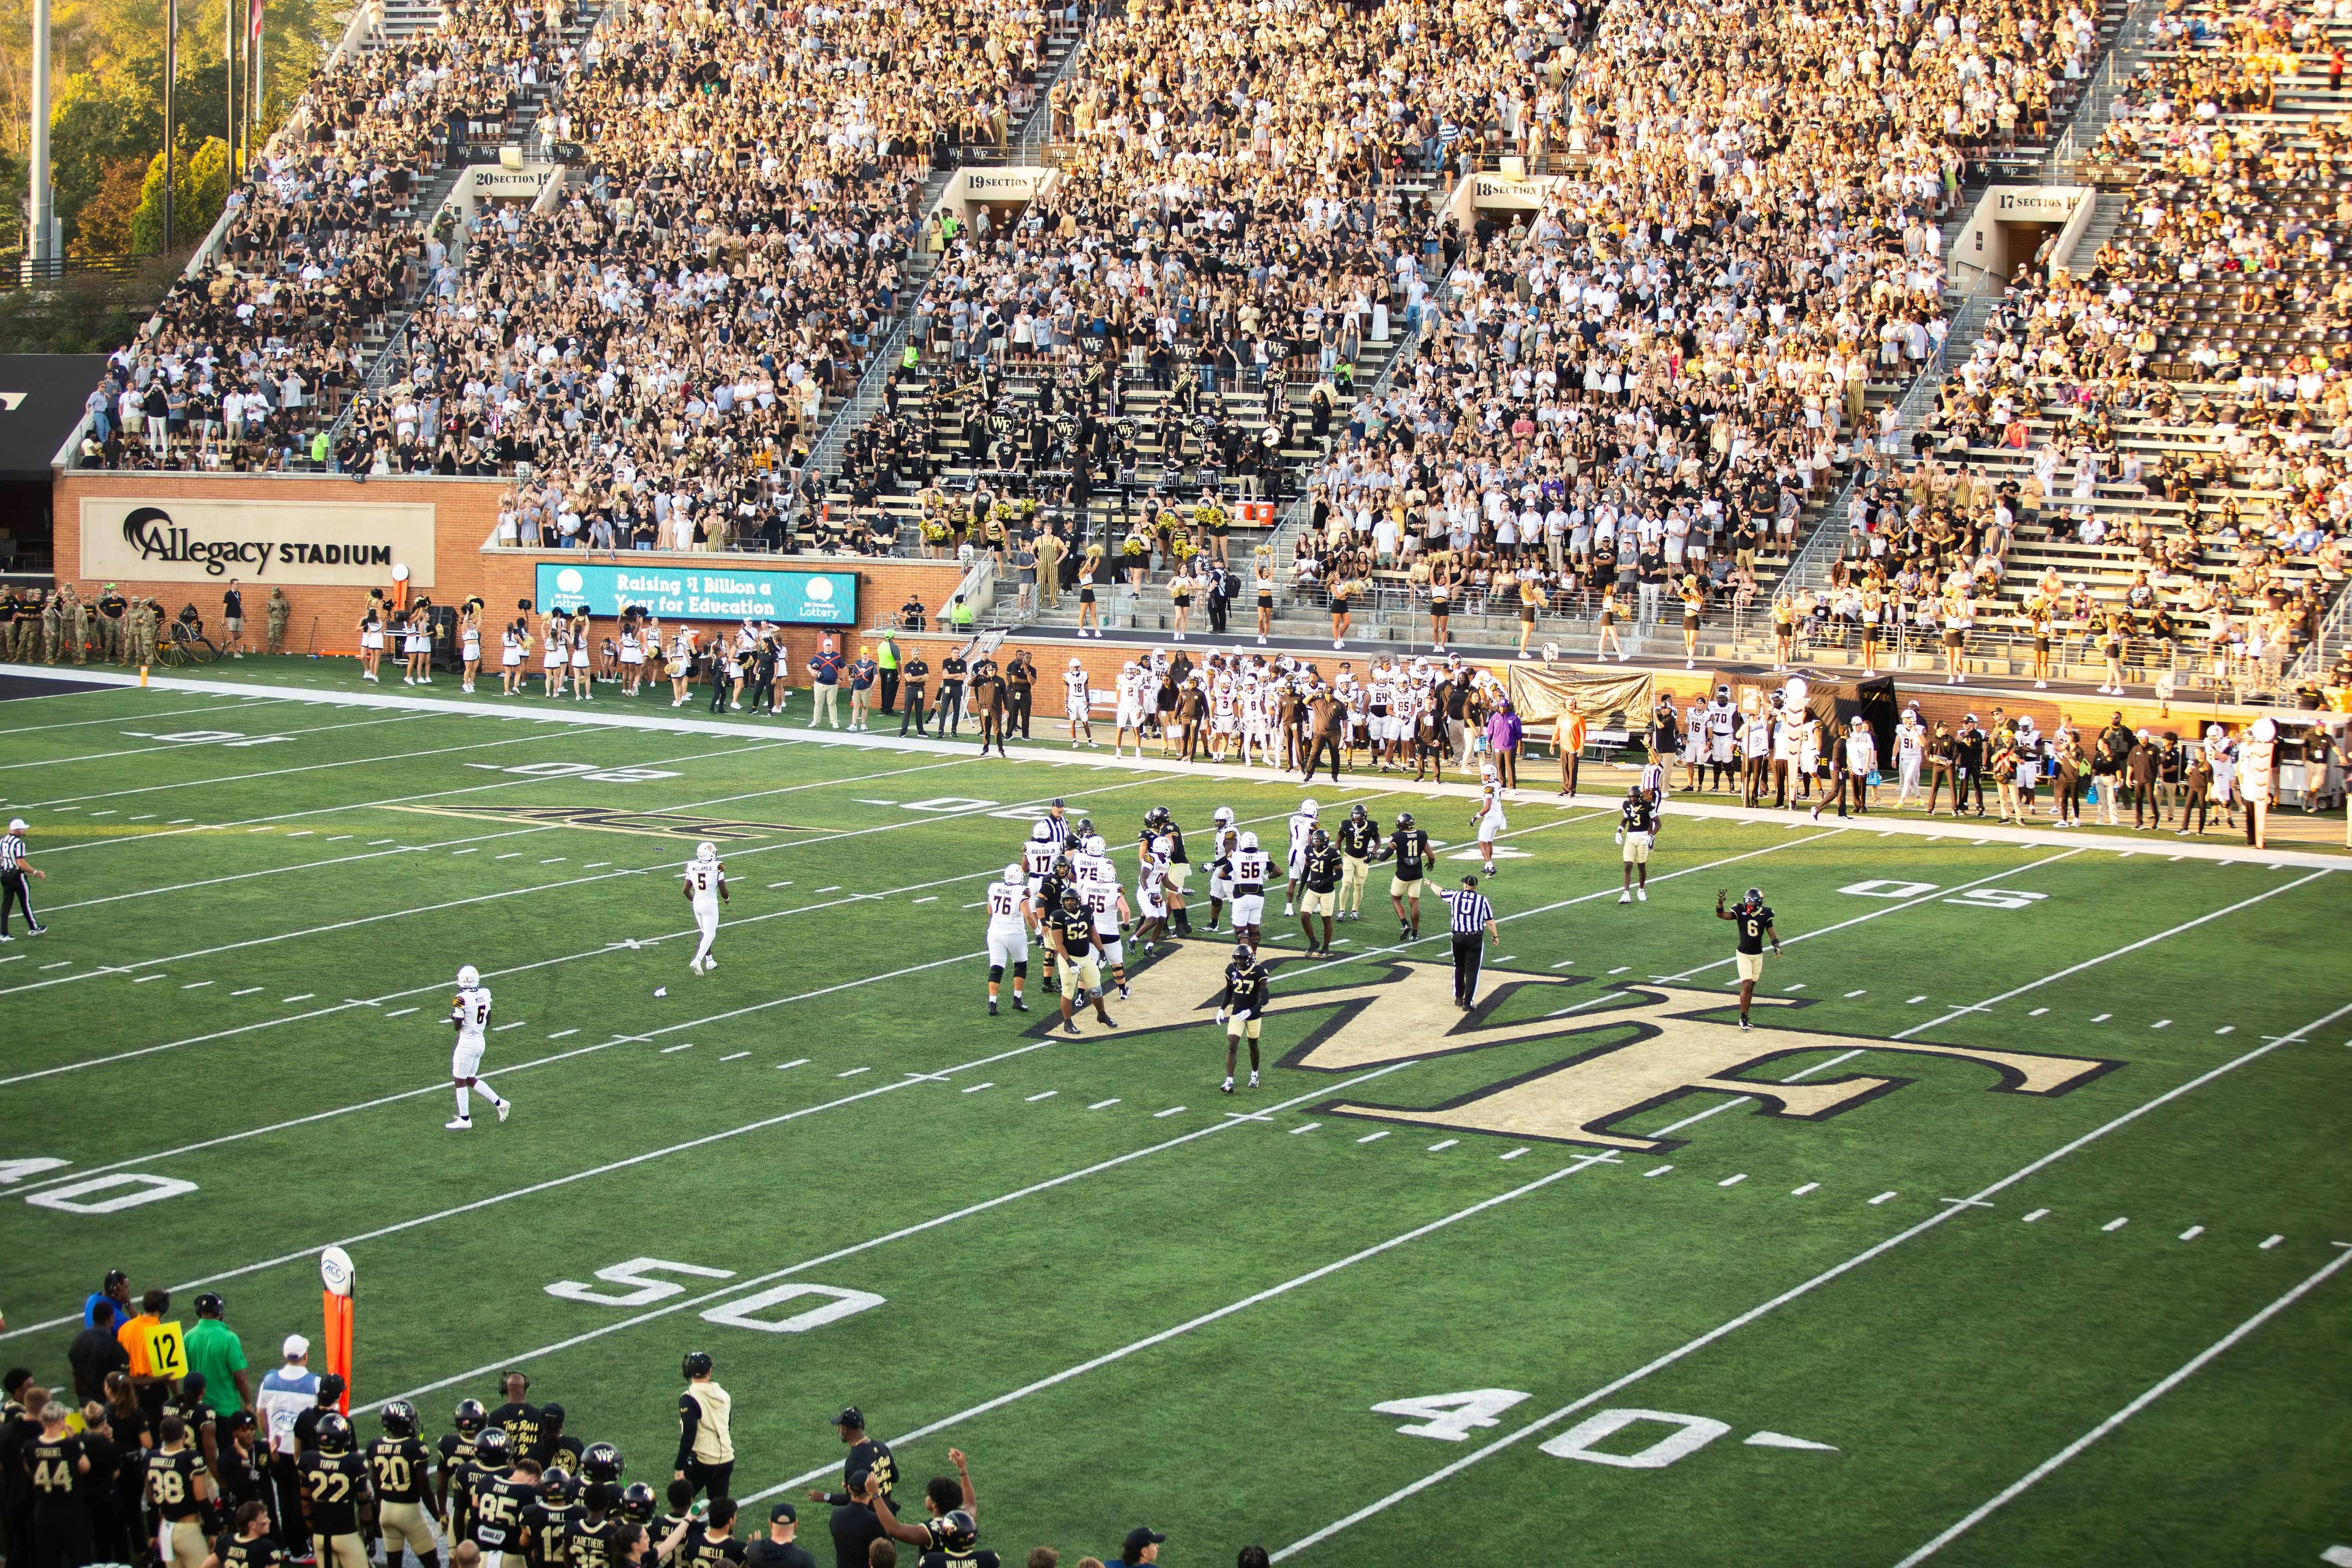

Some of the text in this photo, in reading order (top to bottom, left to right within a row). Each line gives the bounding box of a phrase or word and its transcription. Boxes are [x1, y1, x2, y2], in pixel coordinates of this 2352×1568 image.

[481, 146, 496, 158] WF
[972, 148, 988, 159] WF
[1052, 148, 1068, 160] WF
[1561, 156, 1577, 168] WF
[2002, 165, 2018, 176] WF
[2086, 167, 2103, 180] WF
[2112, 168, 2131, 181] WF
[476, 173, 493, 186] 20
[494, 175, 535, 184] SECTION
[969, 176, 984, 189] 19
[985, 178, 1028, 187] SECTION
[1476, 183, 1492, 196] 18
[1493, 185, 1537, 195] SECTION
[1999, 195, 2013, 209] 17
[2016, 198, 2062, 208] SECTION
[1081, 337, 1103, 352] WF
[1174, 342, 1196, 360] WF
[1267, 341, 1289, 358] WF
[991, 417, 1011, 433] WF
[1057, 422, 1074, 436] WF
[1118, 424, 1134, 437] WF
[1193, 423, 1207, 436] WF
[141, 526, 391, 576] Allegacy STADIUM
[617, 573, 771, 596] Raising $1 Billion a
[551, 598, 590, 608] Lottery
[614, 593, 775, 616] Year for Education
[799, 606, 840, 620] Lottery
[1074, 683, 1082, 693] 18
[1128, 687, 1134, 697] 2
[1376, 692, 1387, 703] 64
[1398, 701, 1409, 712] 85
[1715, 712, 1727, 724] 70
[1692, 721, 1701, 733] 16
[1904, 737, 1913, 749] 91
[369, 805, 851, 842] ACC
[1632, 814, 1641, 826] 3
[1294, 824, 1298, 840] 1
[1353, 835, 1363, 850] 5
[1407, 839, 1418, 857] 11
[1036, 855, 1051, 873] 17
[1240, 861, 1261, 879] 56
[1310, 860, 1324, 873] 21
[1080, 867, 1098, 881] 75
[697, 873, 707, 891] 5
[993, 895, 1011, 915] 76
[1087, 894, 1106, 914] 65
[1461, 899, 1474, 914] U
[1066, 921, 1088, 941] 52
[1747, 919, 1758, 938] 6
[1232, 978, 1254, 995] 27
[477, 1005, 486, 1024] 6
[1022, 937, 2129, 1155] WF
[325, 1263, 342, 1276] ACC
[543, 1257, 889, 1332] 50
[153, 1333, 179, 1370] 12
[388, 1402, 408, 1419] WF
[503, 1419, 539, 1433] THE BALL
[1370, 1387, 1733, 1469] 40
[519, 1432, 538, 1444] BALL
[377, 1444, 401, 1454] WEBB JR
[594, 1448, 614, 1463] WF
[319, 1459, 341, 1470] TURPIN
[34, 1460, 73, 1493] 44
[373, 1455, 412, 1492] 20
[469, 1471, 486, 1483] STEV
[148, 1468, 185, 1505] 38
[309, 1470, 350, 1504] 22
[492, 1482, 510, 1494] RYAN
[479, 1492, 518, 1527] 85
[548, 1512, 566, 1523] MULL
[480, 1529, 503, 1541] DOUGLAS
[573, 1534, 605, 1550] CARETHERS
[541, 1525, 565, 1562] 12
[228, 1545, 248, 1559] JOSEPH
[699, 1545, 725, 1560] RINELLO
[946, 1558, 978, 1568] WILLIAMS
